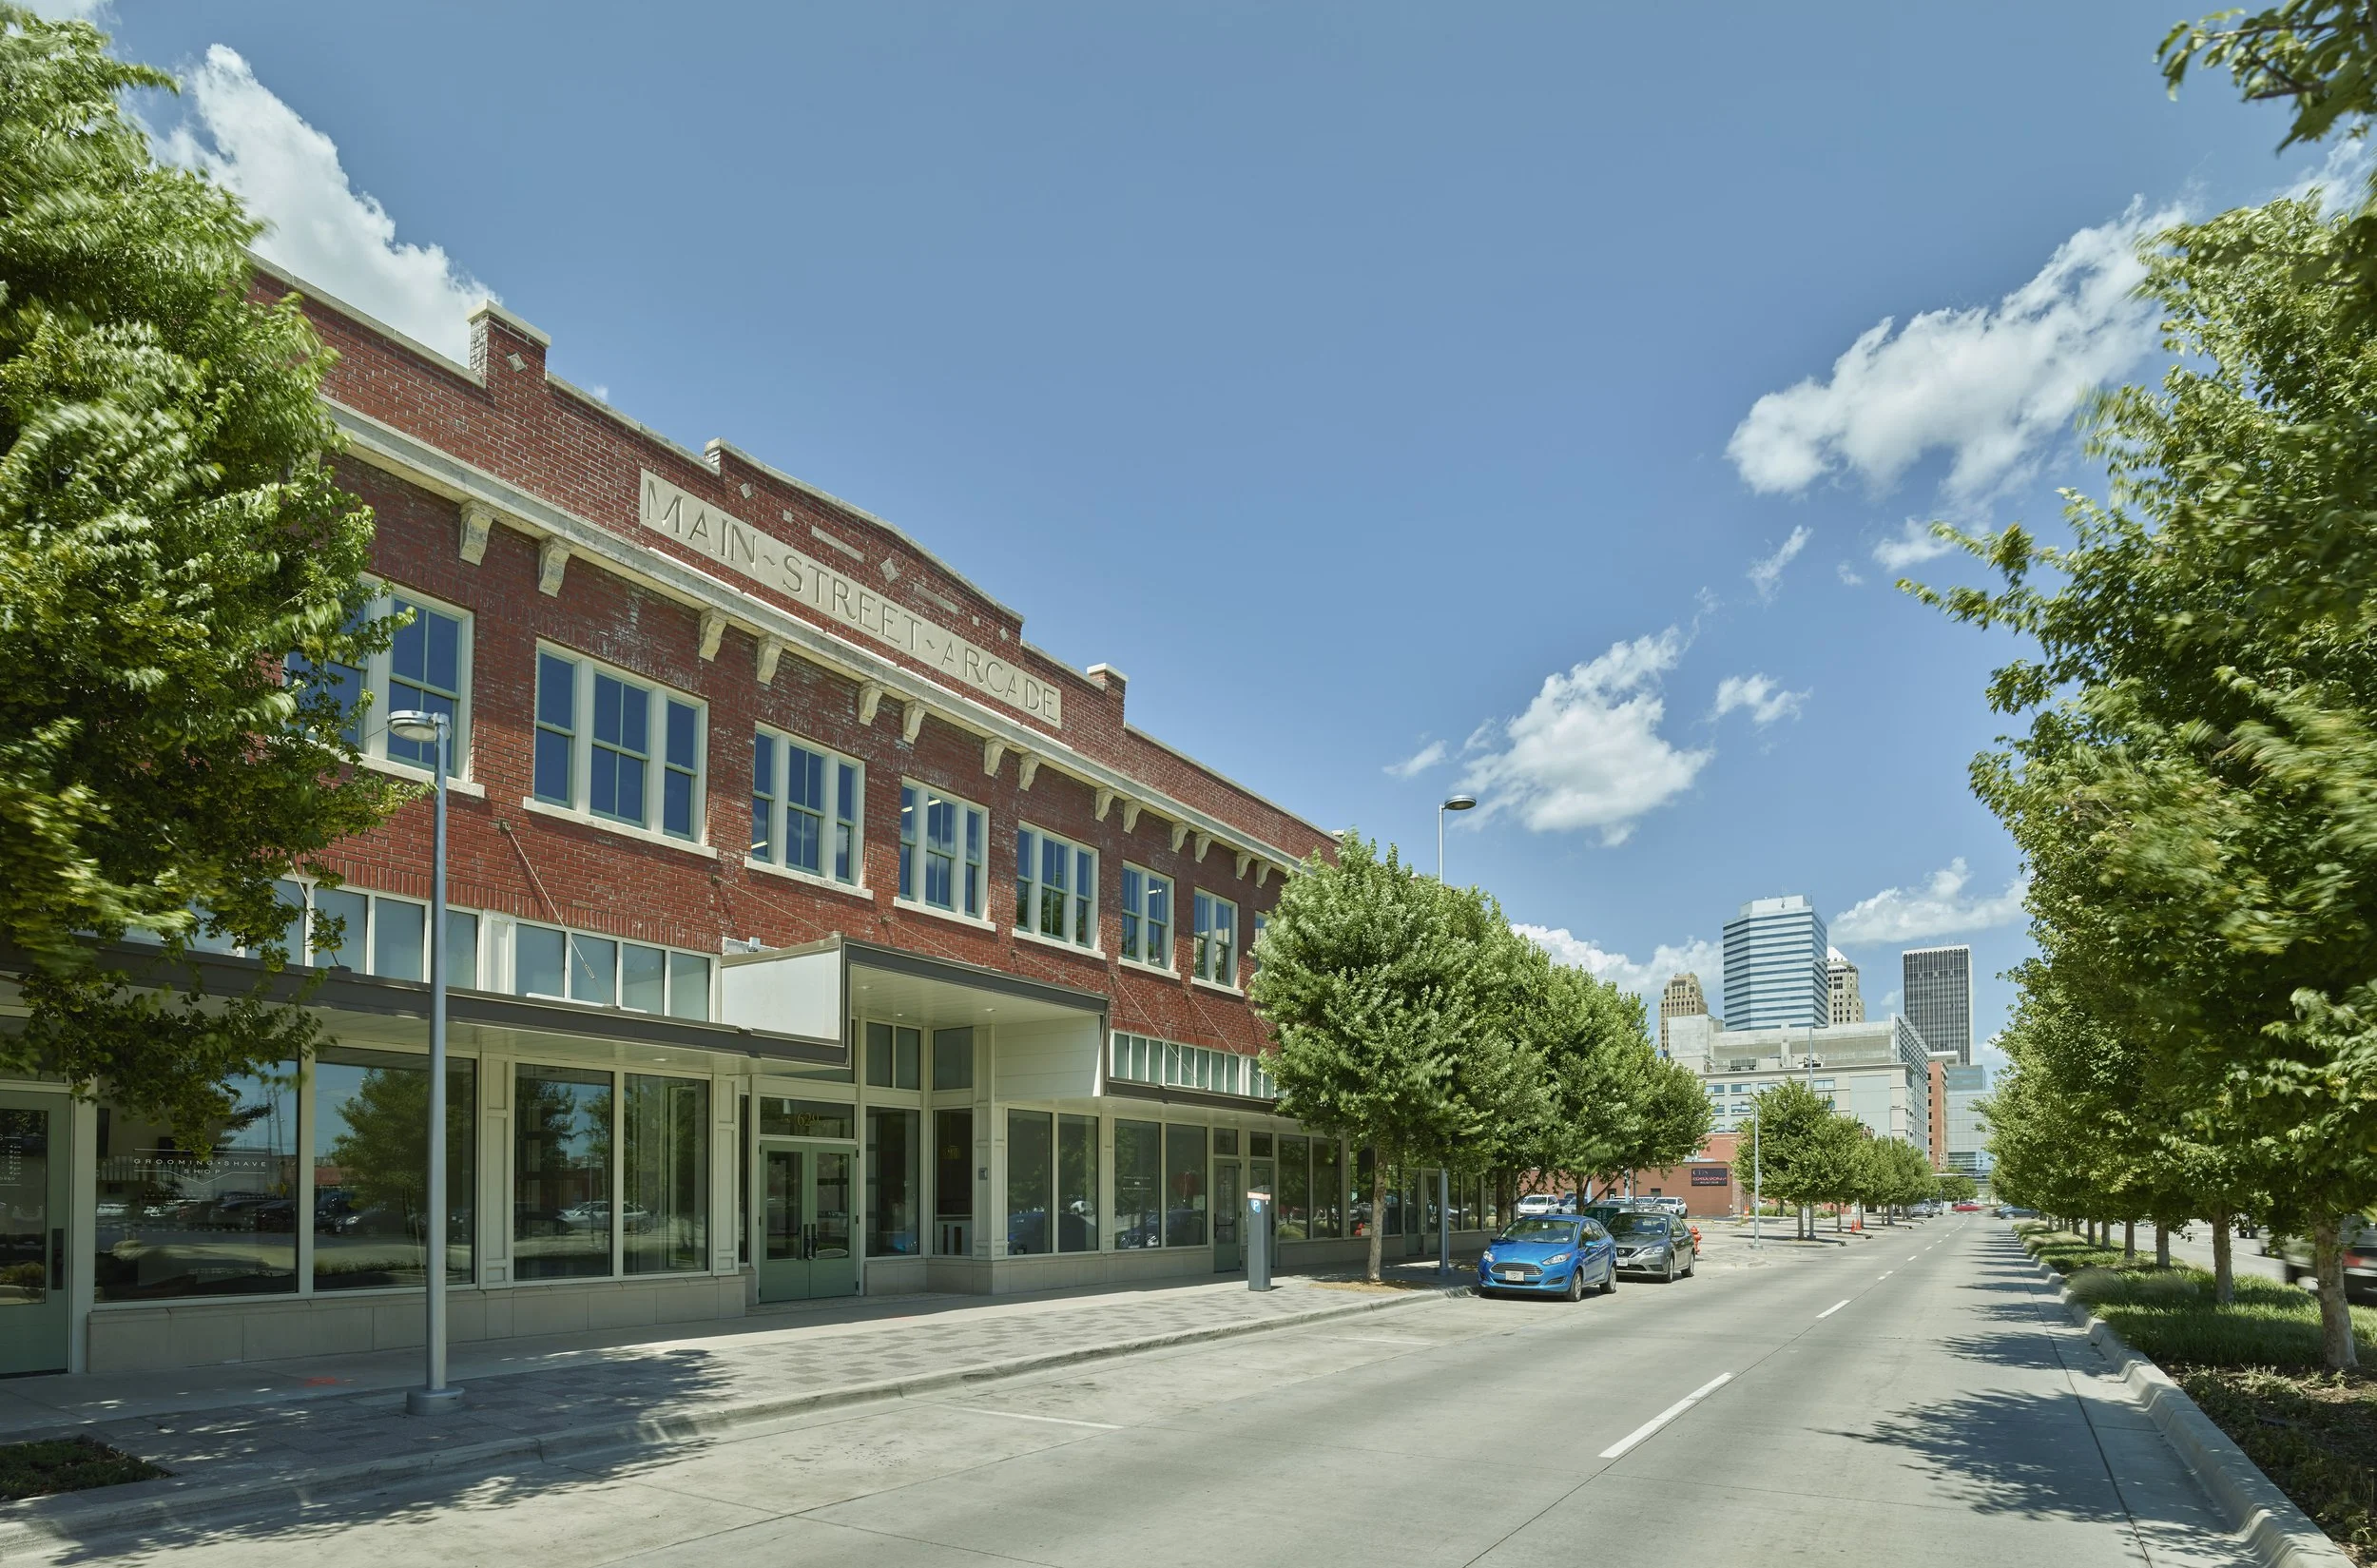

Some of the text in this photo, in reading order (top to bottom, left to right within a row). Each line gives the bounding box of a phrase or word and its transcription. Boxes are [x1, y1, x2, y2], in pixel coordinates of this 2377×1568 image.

[647, 478, 1058, 722] MAIN STREET ARCADE
[223, 1159, 266, 1168] SHAVE
